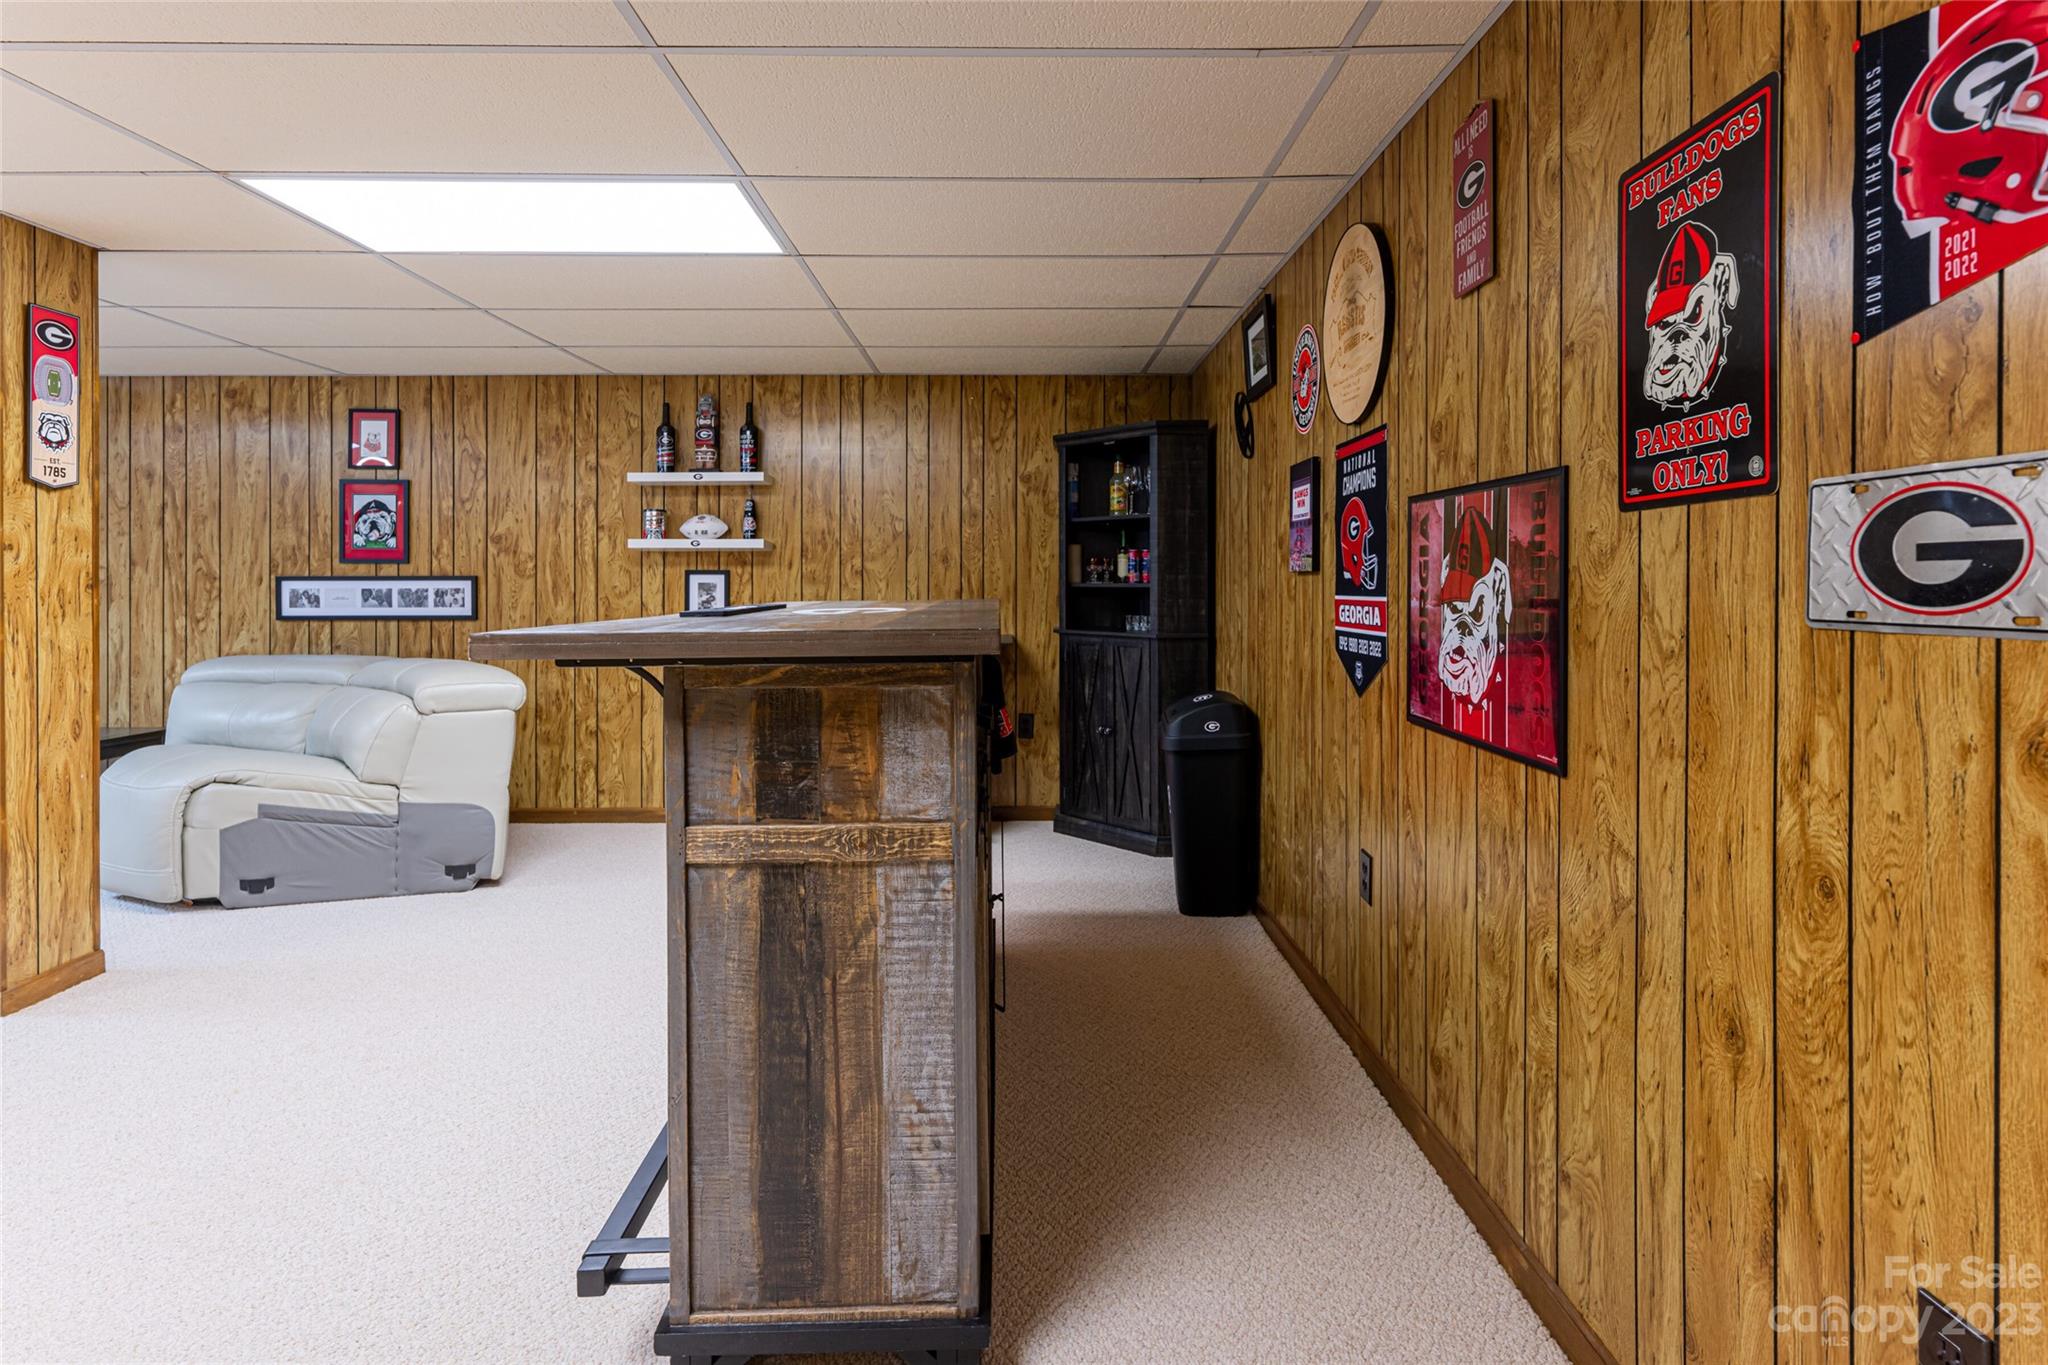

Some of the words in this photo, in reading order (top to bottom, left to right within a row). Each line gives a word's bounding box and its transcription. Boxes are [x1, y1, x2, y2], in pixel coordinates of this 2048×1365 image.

[1866, 65, 1882, 133] DAWGS
[1454, 138, 1464, 159] ALL
[1470, 110, 1488, 142] NEED
[1468, 144, 1473, 159] IS
[1629, 103, 1761, 210] BULLDOGS
[1866, 142, 1882, 197] THEM
[1657, 168, 1722, 230] FANS
[1454, 200, 1489, 241] FOOTBALL
[1456, 221, 1487, 259] FRIENDS
[1466, 250, 1477, 267] AND
[1945, 227, 1977, 257] 2021
[1458, 258, 1485, 293] FAMILY
[1945, 252, 1978, 282] 2022
[1866, 274, 1882, 317] HOW
[1635, 403, 1751, 459] PARKING
[43, 465, 66, 478] 1785
[1343, 449, 1376, 474] NATIONAL
[1343, 467, 1376, 496] CHAMPIONS
[1653, 449, 1728, 492] ONLY!
[1858, 490, 2025, 608] G
[1339, 604, 1381, 627] GEORGIA
[1418, 511, 1430, 705] GEORGIA
[1530, 490, 1549, 747] BULLDOGS
